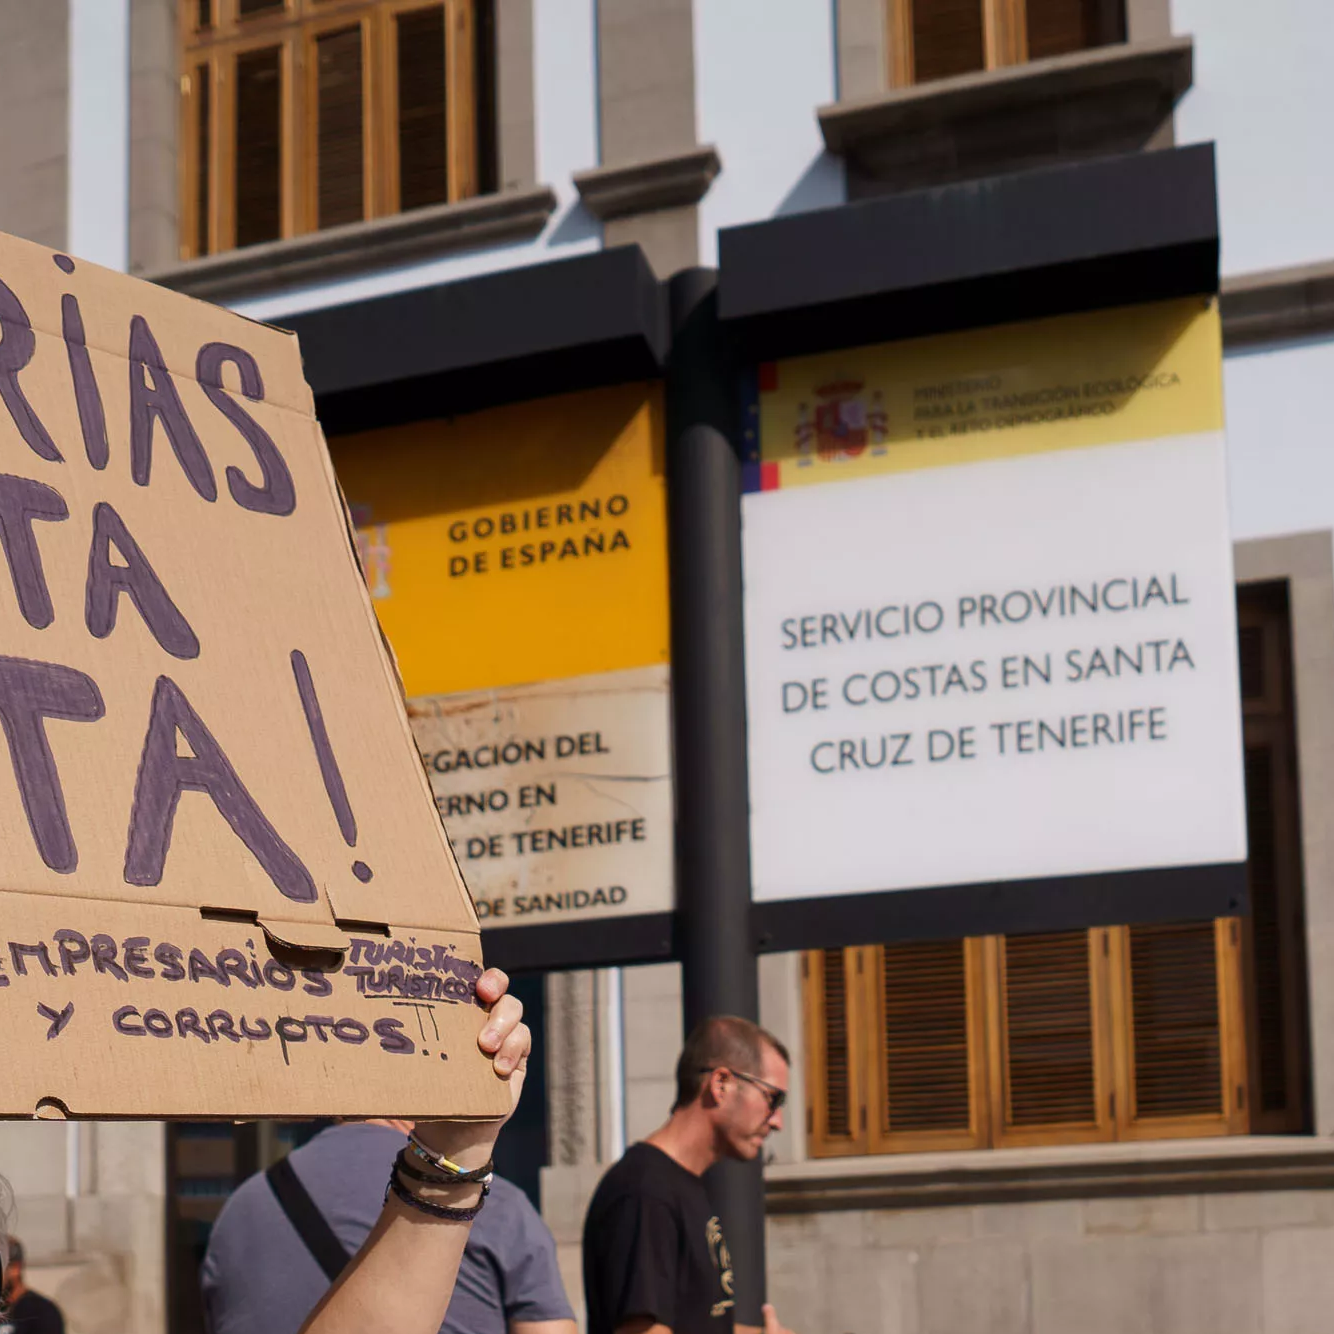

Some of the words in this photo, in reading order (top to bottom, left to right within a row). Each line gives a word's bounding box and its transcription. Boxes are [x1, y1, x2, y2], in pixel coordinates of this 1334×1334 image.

[448, 494, 632, 544] GOBIERNO
[448, 552, 489, 579] DE
[500, 526, 632, 570] ESPAÑA
[779, 599, 945, 651] SERVICIO
[957, 572, 1190, 630] PROVINCIAL
[780, 678, 829, 714] DE
[841, 659, 988, 708] COSTAS
[1000, 653, 1052, 690] EN
[1065, 638, 1196, 683] SANTA
[554, 731, 610, 759] DEL
[808, 732, 915, 775] CRUZ
[926, 727, 976, 763] DE
[988, 707, 1168, 756] TENERIFE
[518, 782, 557, 809] EN
[466, 834, 503, 861] DE
[510, 817, 647, 855] TENERIFE
[476, 898, 505, 919] DE
[513, 885, 628, 915] SANIDAD
[37, 1000, 74, 1042] Y
